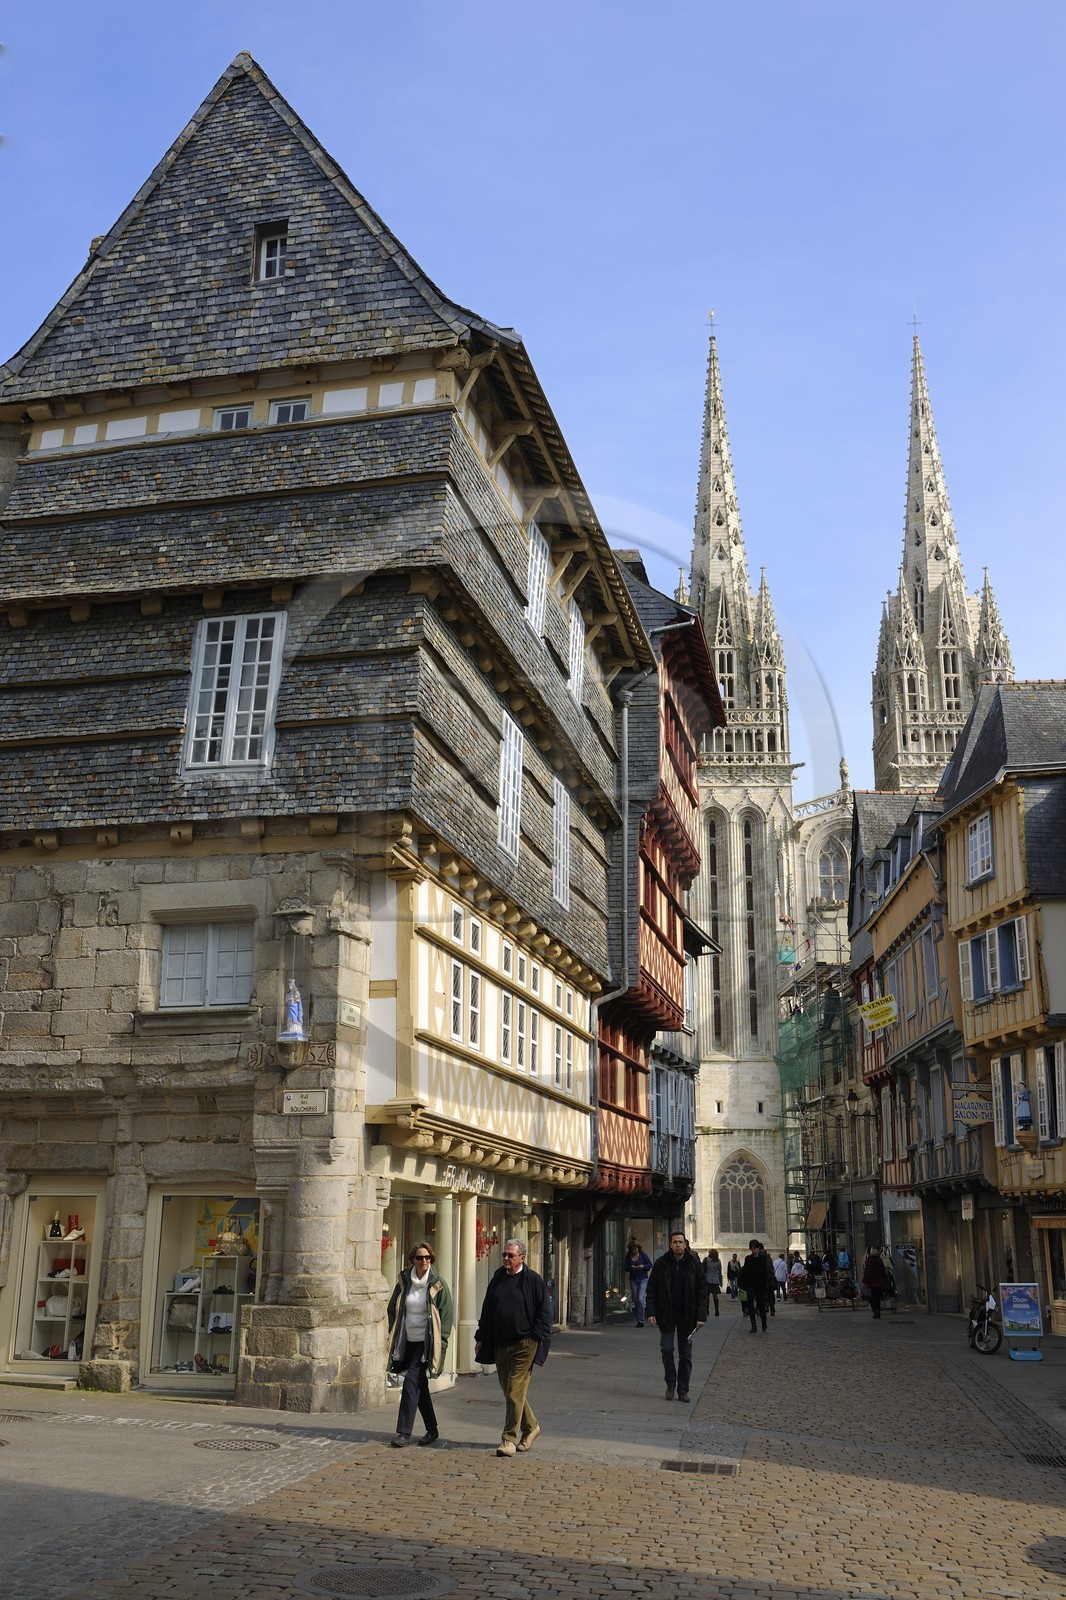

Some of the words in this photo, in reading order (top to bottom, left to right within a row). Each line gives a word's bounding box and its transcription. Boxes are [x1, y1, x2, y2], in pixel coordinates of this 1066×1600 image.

[867, 996, 894, 1009] VENDRE
[290, 1105, 318, 1113] BOUCHERIES
[954, 1111, 978, 1119] SALON
